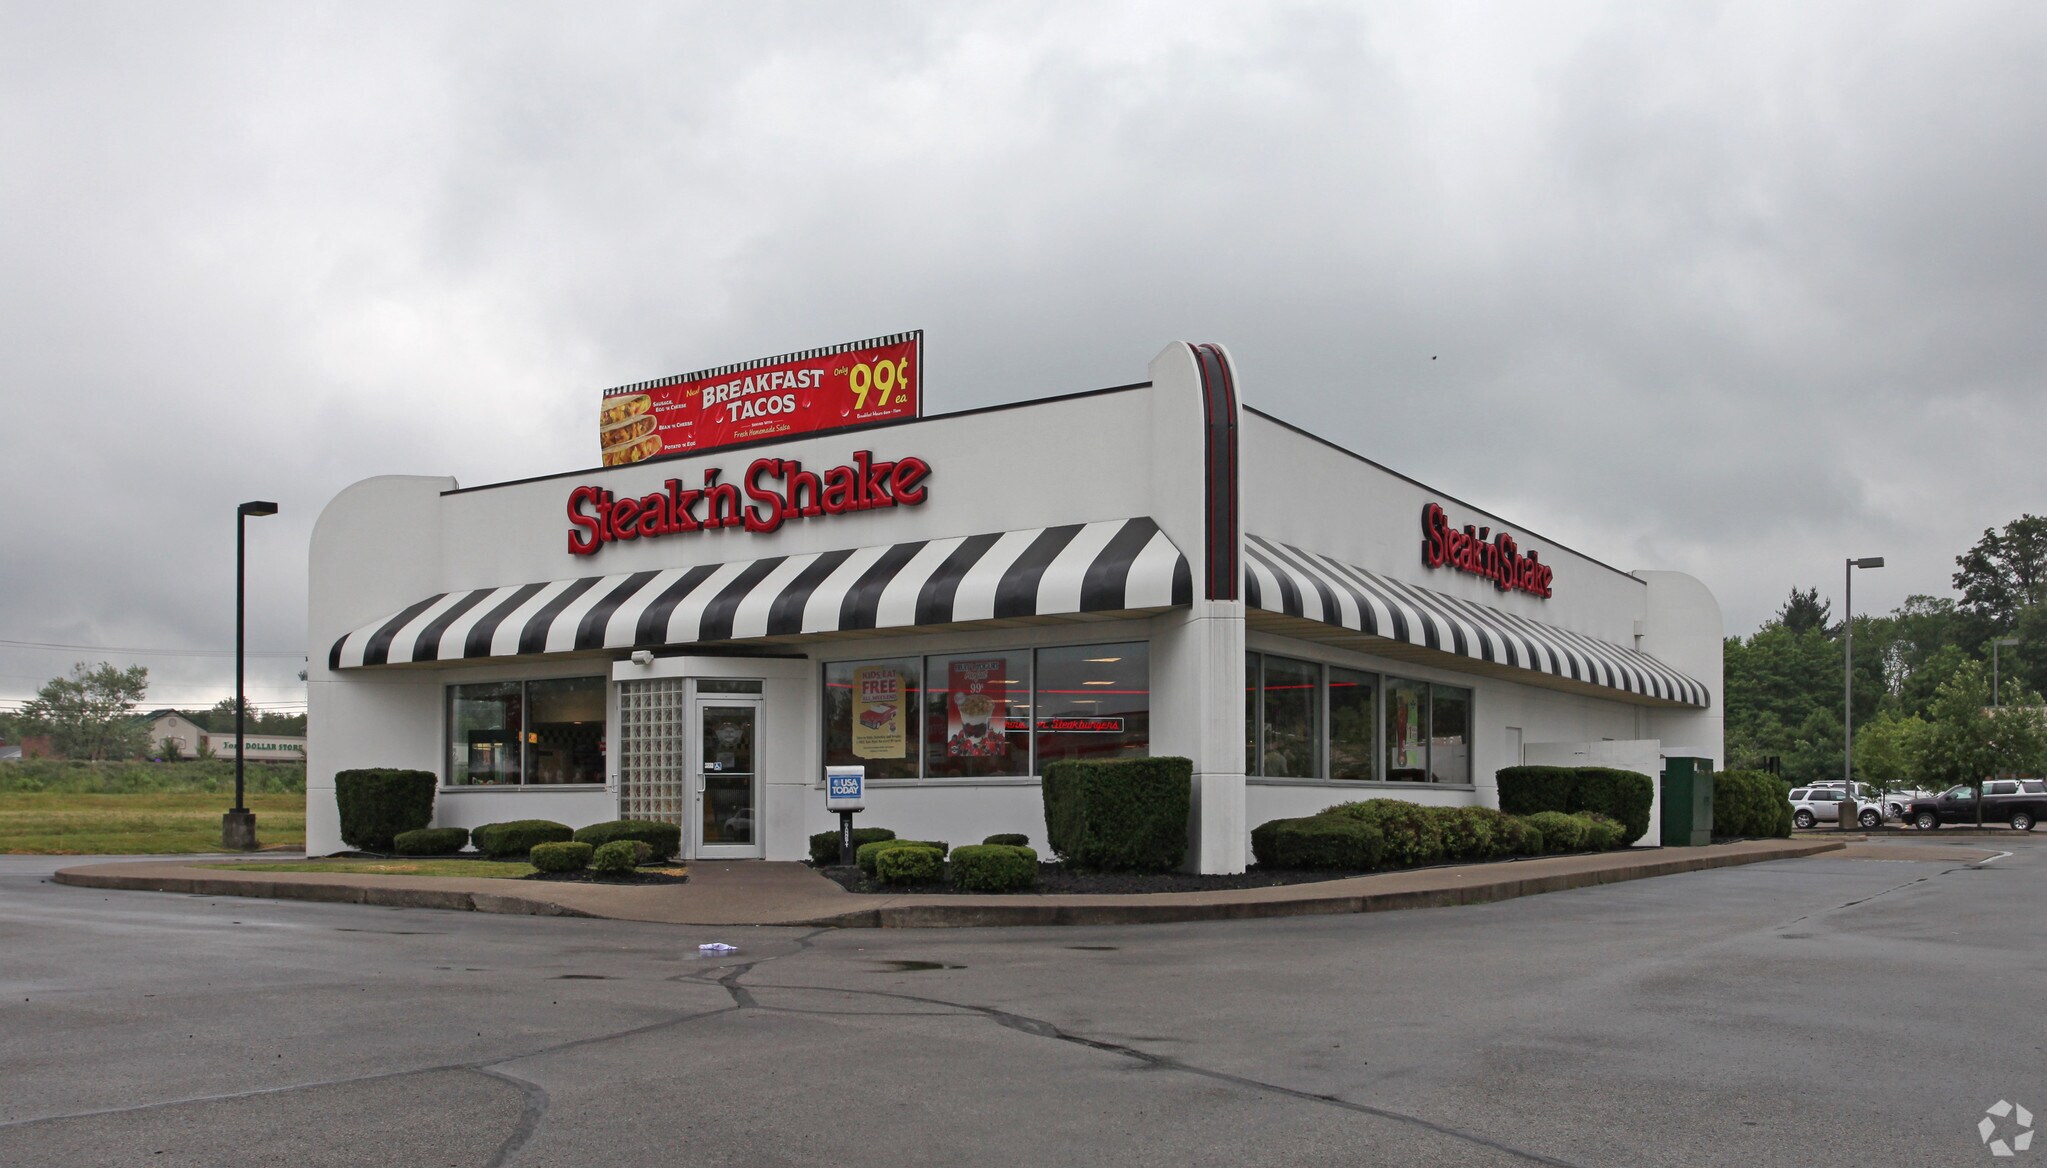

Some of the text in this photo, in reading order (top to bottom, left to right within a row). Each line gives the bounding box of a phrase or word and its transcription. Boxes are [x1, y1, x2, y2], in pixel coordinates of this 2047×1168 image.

[834, 366, 848, 376] Only
[702, 369, 825, 410] BREAKFAST
[849, 356, 908, 410] 99¢
[895, 394, 907, 404] ea
[726, 394, 796, 422] TACOS
[733, 423, 791, 439] Fresh Homemade Salsa
[744, 450, 931, 533] Shake
[1494, 532, 1553, 599] Shake
[862, 669, 896, 679] KIDS EAT
[862, 679, 897, 694] FREE
[245, 743, 277, 751] DOLLAR
[841, 778, 858, 787] USA
[832, 786, 859, 795] TODAY
